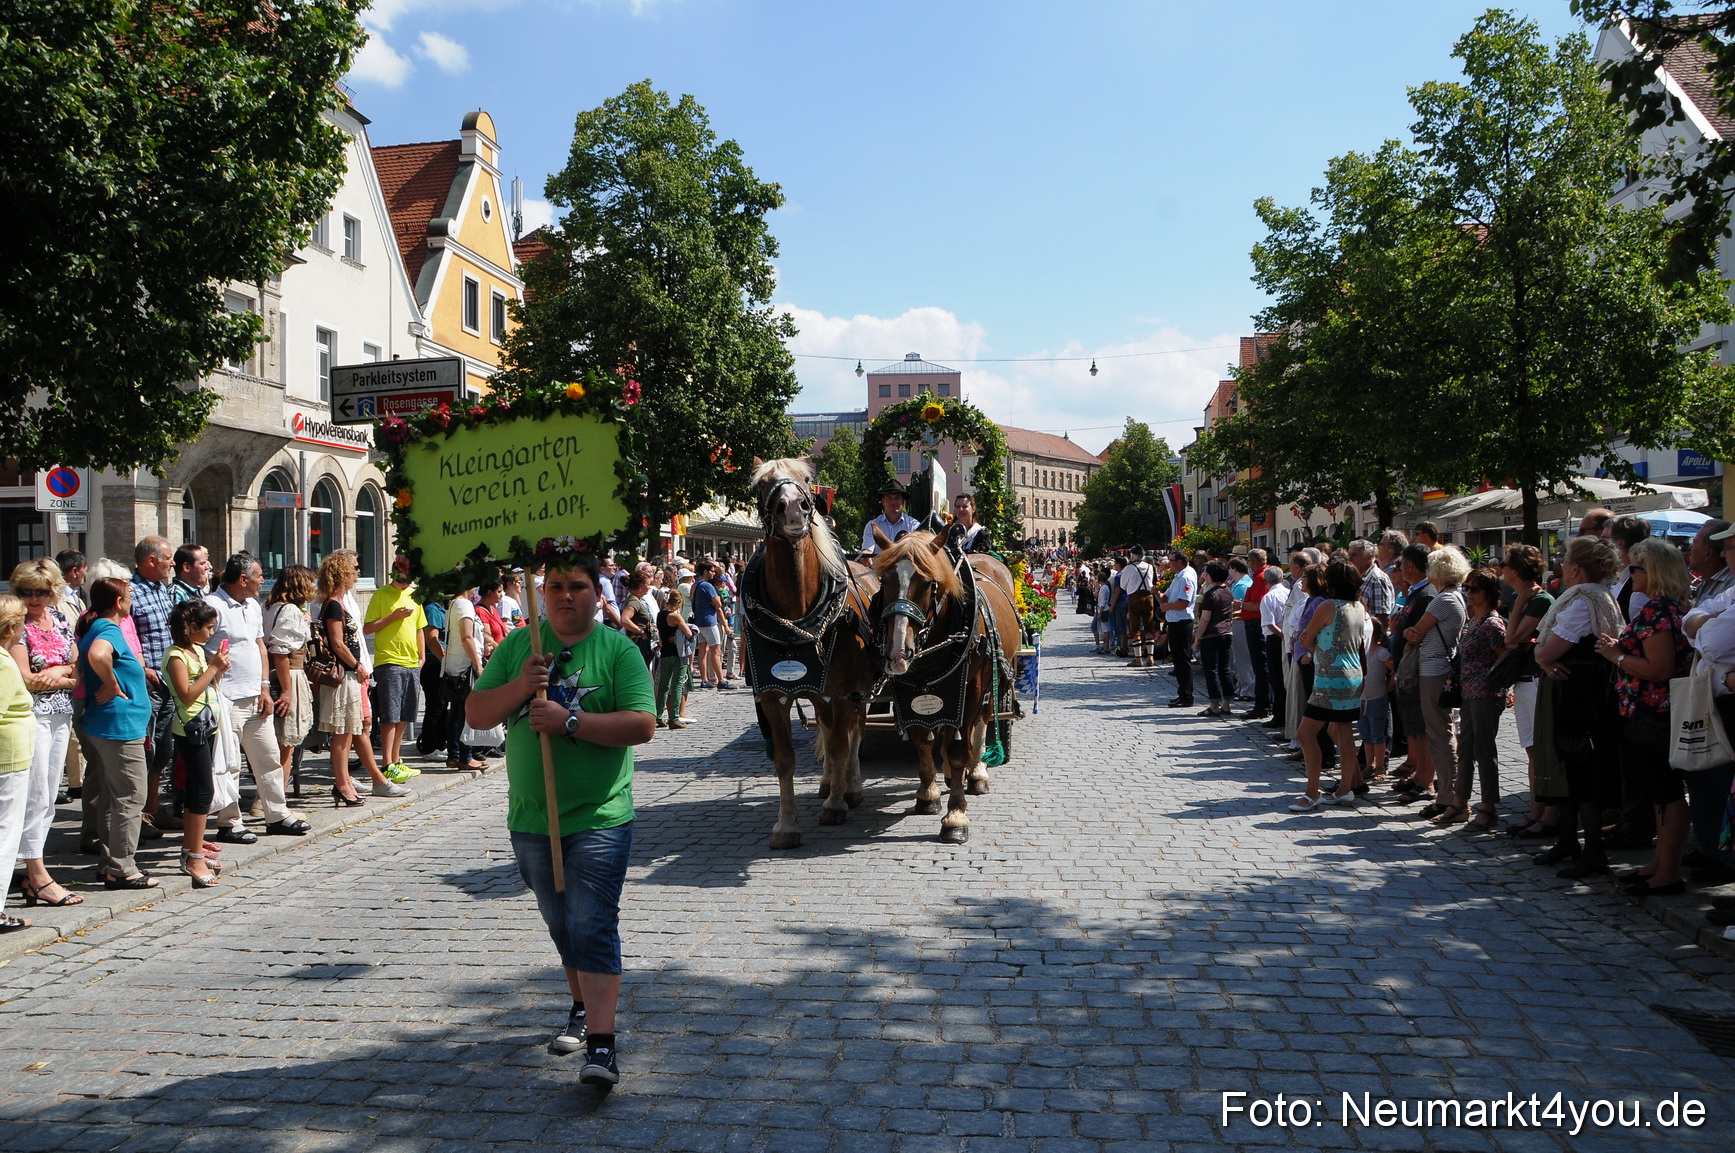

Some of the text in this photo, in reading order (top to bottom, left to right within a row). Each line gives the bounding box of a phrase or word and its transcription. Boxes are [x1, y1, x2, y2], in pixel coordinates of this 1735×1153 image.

[352, 368, 437, 387] Parkleitsystem
[383, 396, 439, 411] Rosengasse
[304, 415, 369, 443] HypoVereinsbank
[439, 435, 583, 480] Kleingarten
[1681, 455, 1712, 467] APOLLO
[449, 458, 574, 506] Verein e.V.
[50, 500, 77, 508] ZONE
[442, 508, 519, 537] Neumarkt
